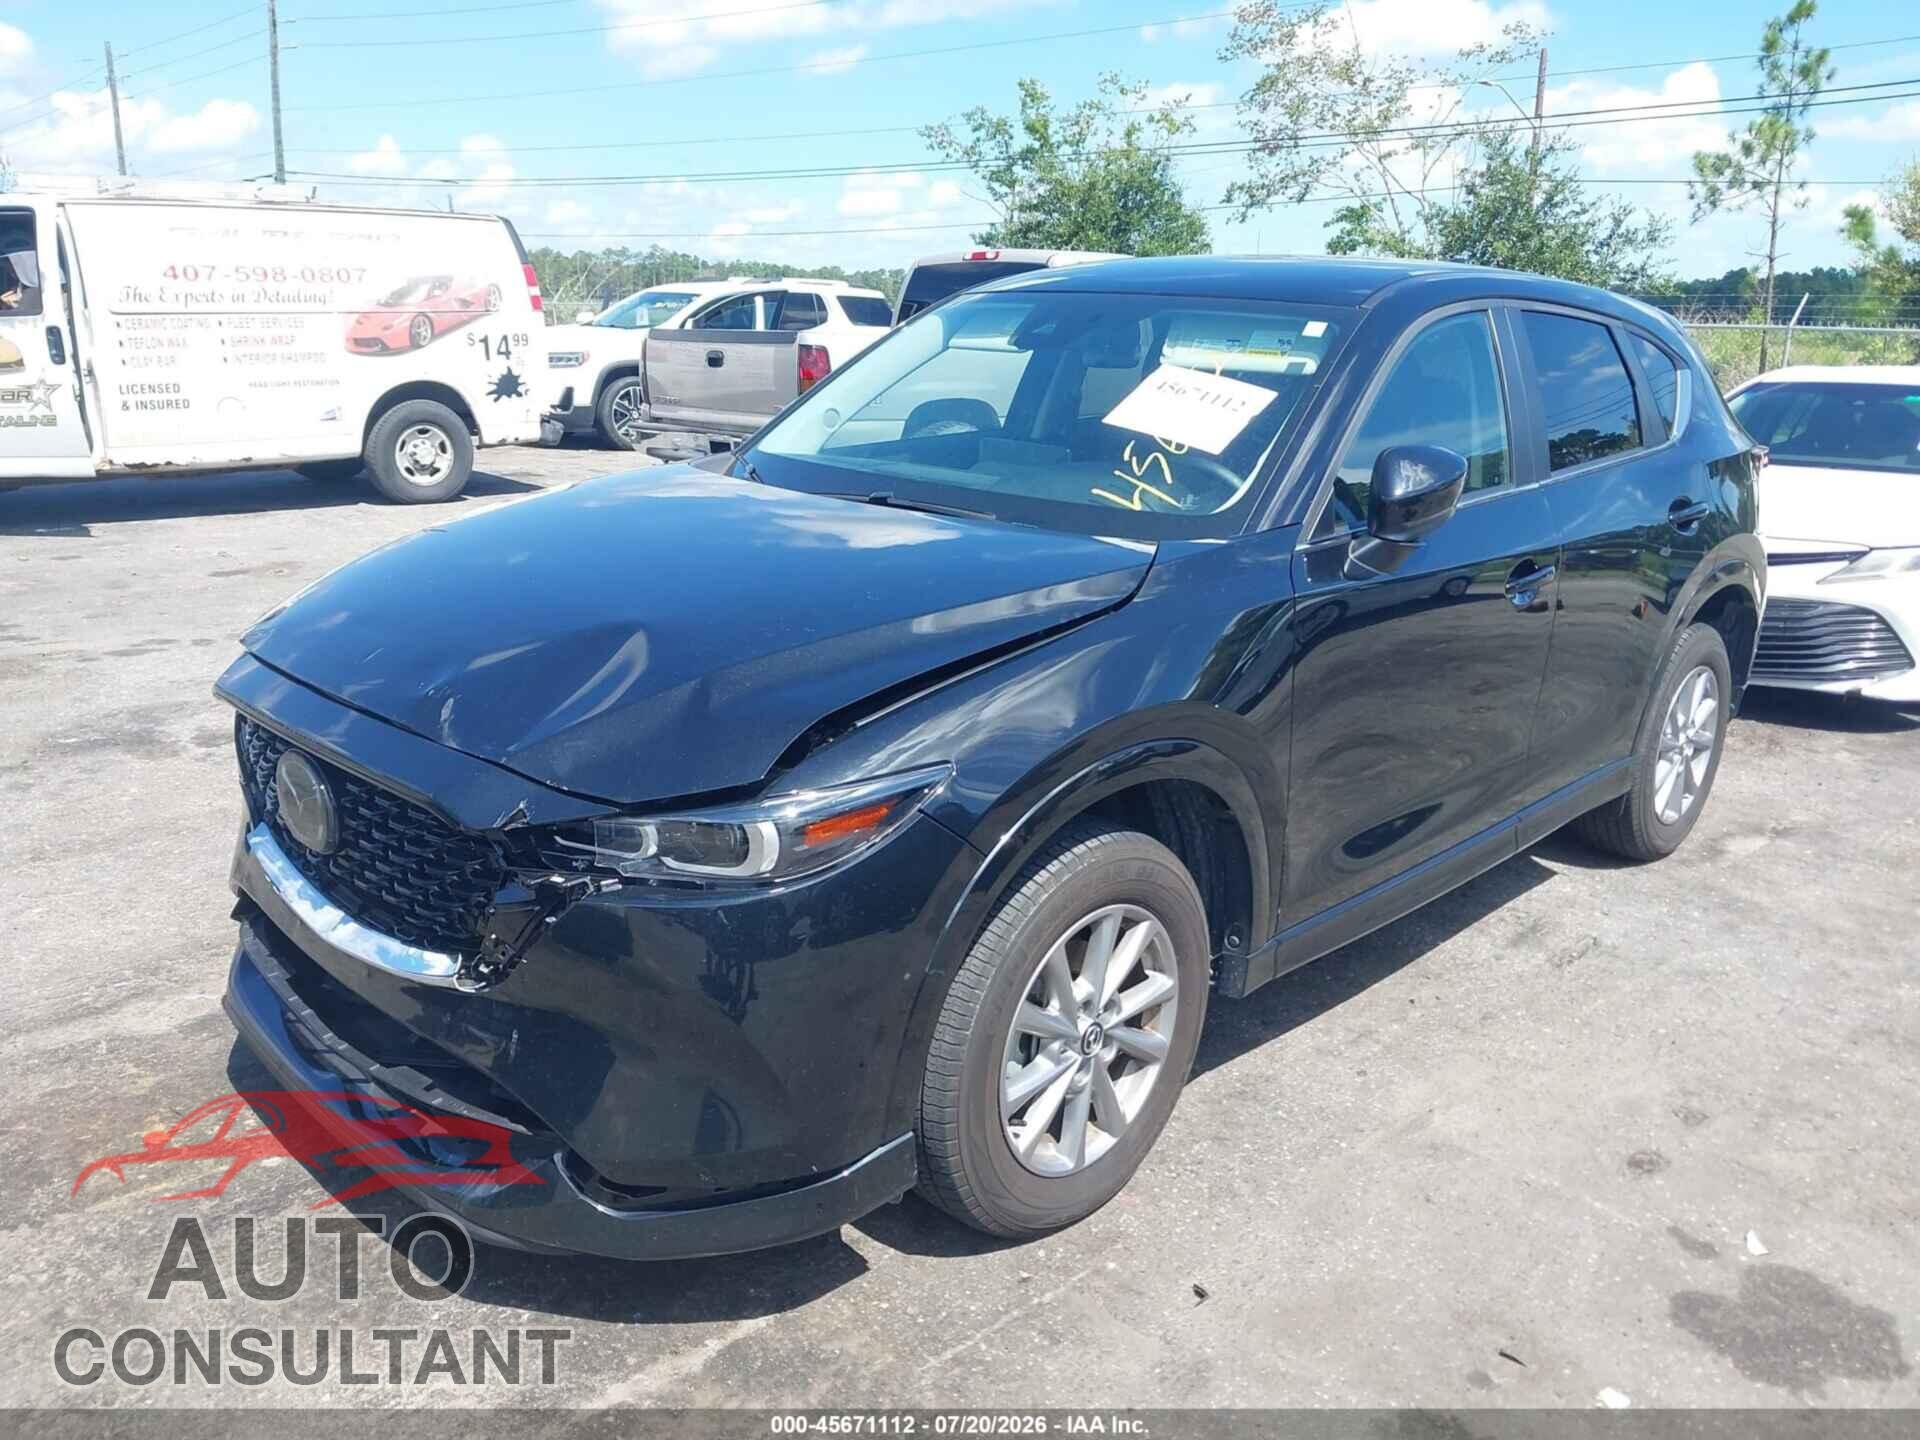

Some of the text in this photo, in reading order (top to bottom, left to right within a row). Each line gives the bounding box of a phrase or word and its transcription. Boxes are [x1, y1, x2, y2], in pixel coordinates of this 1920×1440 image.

[162, 263, 368, 284] 407-598-0807
[119, 382, 181, 395] LICENSED
[121, 398, 190, 411] & INSURED
